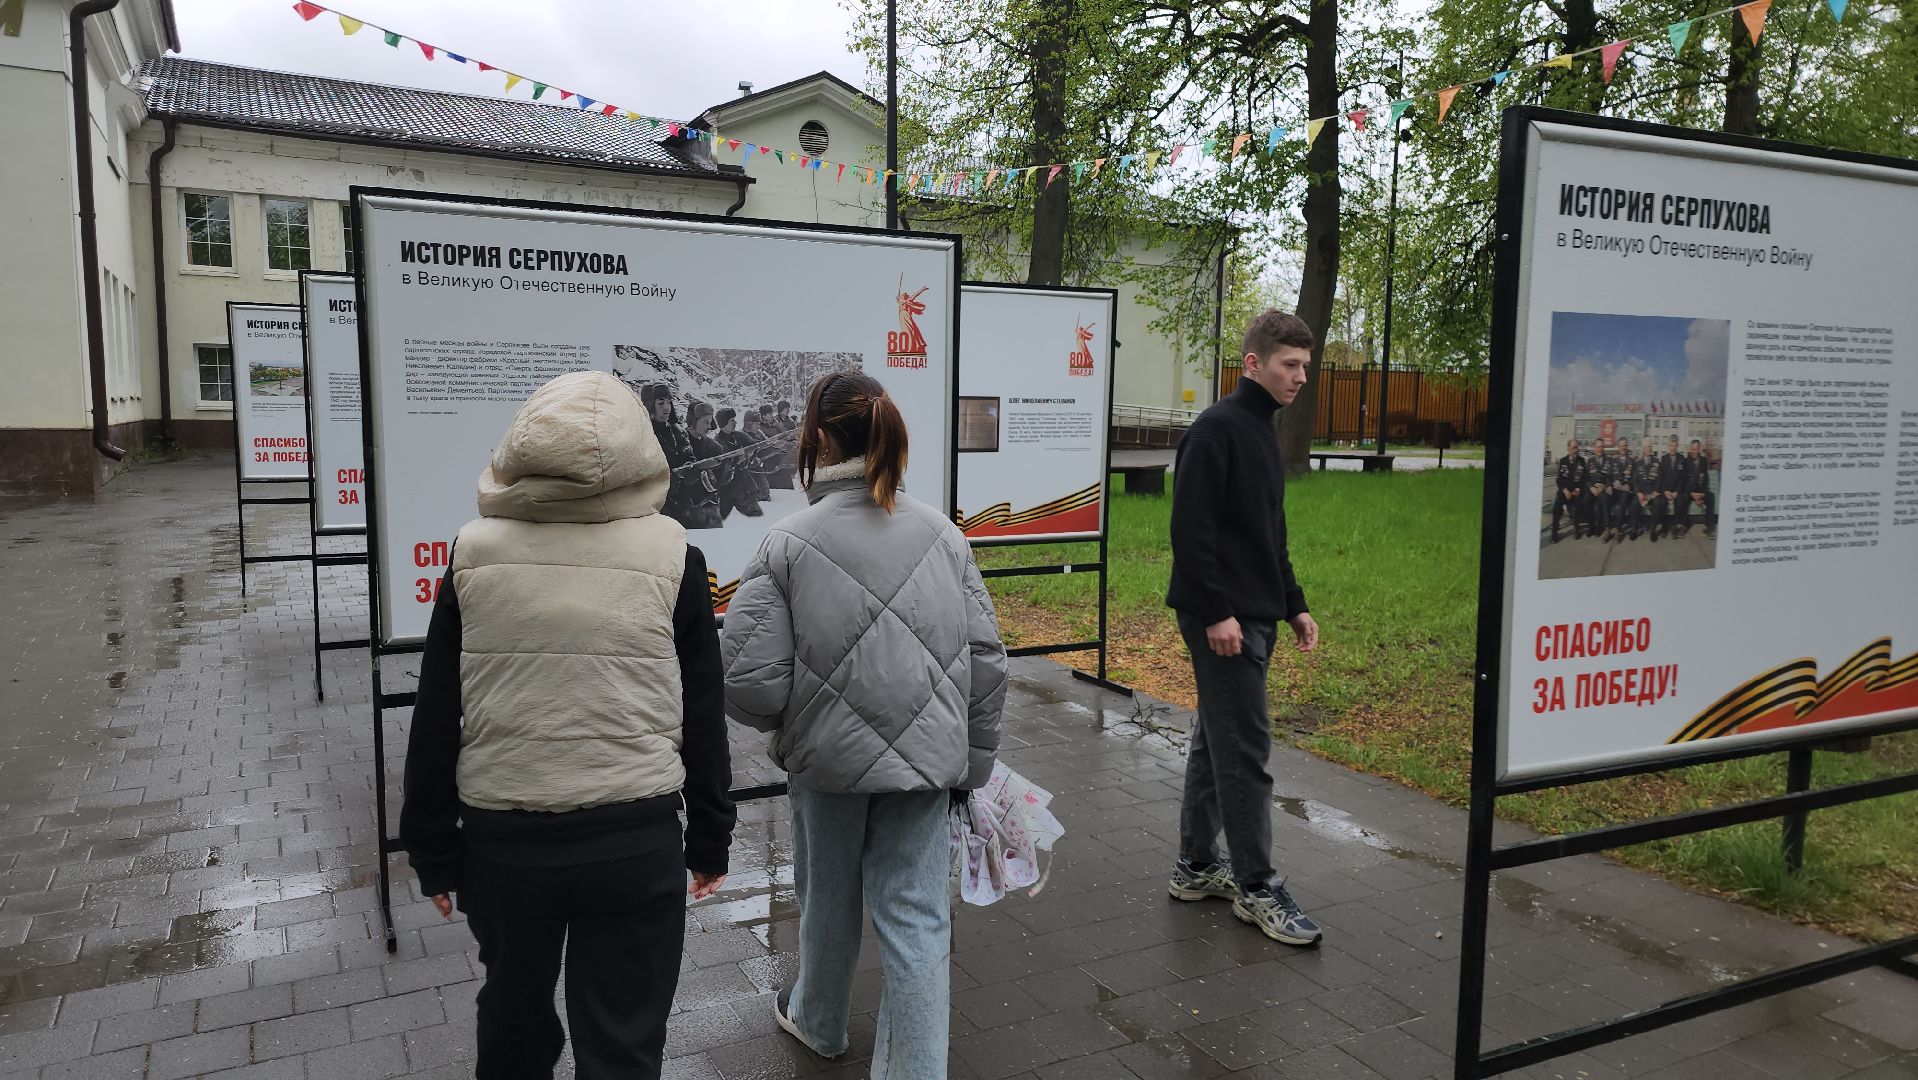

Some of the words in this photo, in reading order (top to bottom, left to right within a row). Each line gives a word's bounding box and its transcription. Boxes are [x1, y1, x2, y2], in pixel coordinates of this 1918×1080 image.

[1559, 183, 1655, 223] ИСТОРИЯ
[1661, 194, 1771, 235] СЕРПУХОВА
[400, 241, 501, 269] ИСТОРИЯ
[508, 248, 629, 276] СЕРПУХОВА
[1556, 231, 1567, 247] в
[1572, 228, 1644, 257] Великую
[1649, 235, 1766, 267] Отечественную
[1770, 246, 1813, 271] Войну
[402, 273, 411, 285] в
[418, 271, 494, 293] Великую
[500, 276, 625, 299] Отечественную
[630, 283, 677, 301] Войну
[246, 319, 289, 330] ИСТОРИЯ
[887, 331, 910, 353] 80
[887, 357, 928, 370] ПОБЕДА!
[254, 437, 305, 448] СПАСИБО
[255, 452, 269, 462] ЗА
[273, 452, 308, 463] ПОБЕД
[338, 489, 359, 504] ЗА
[1535, 617, 1651, 662] СПАСИБО
[1532, 676, 1566, 714] ЗА
[1575, 664, 1678, 708] ПОБЕДУ!
